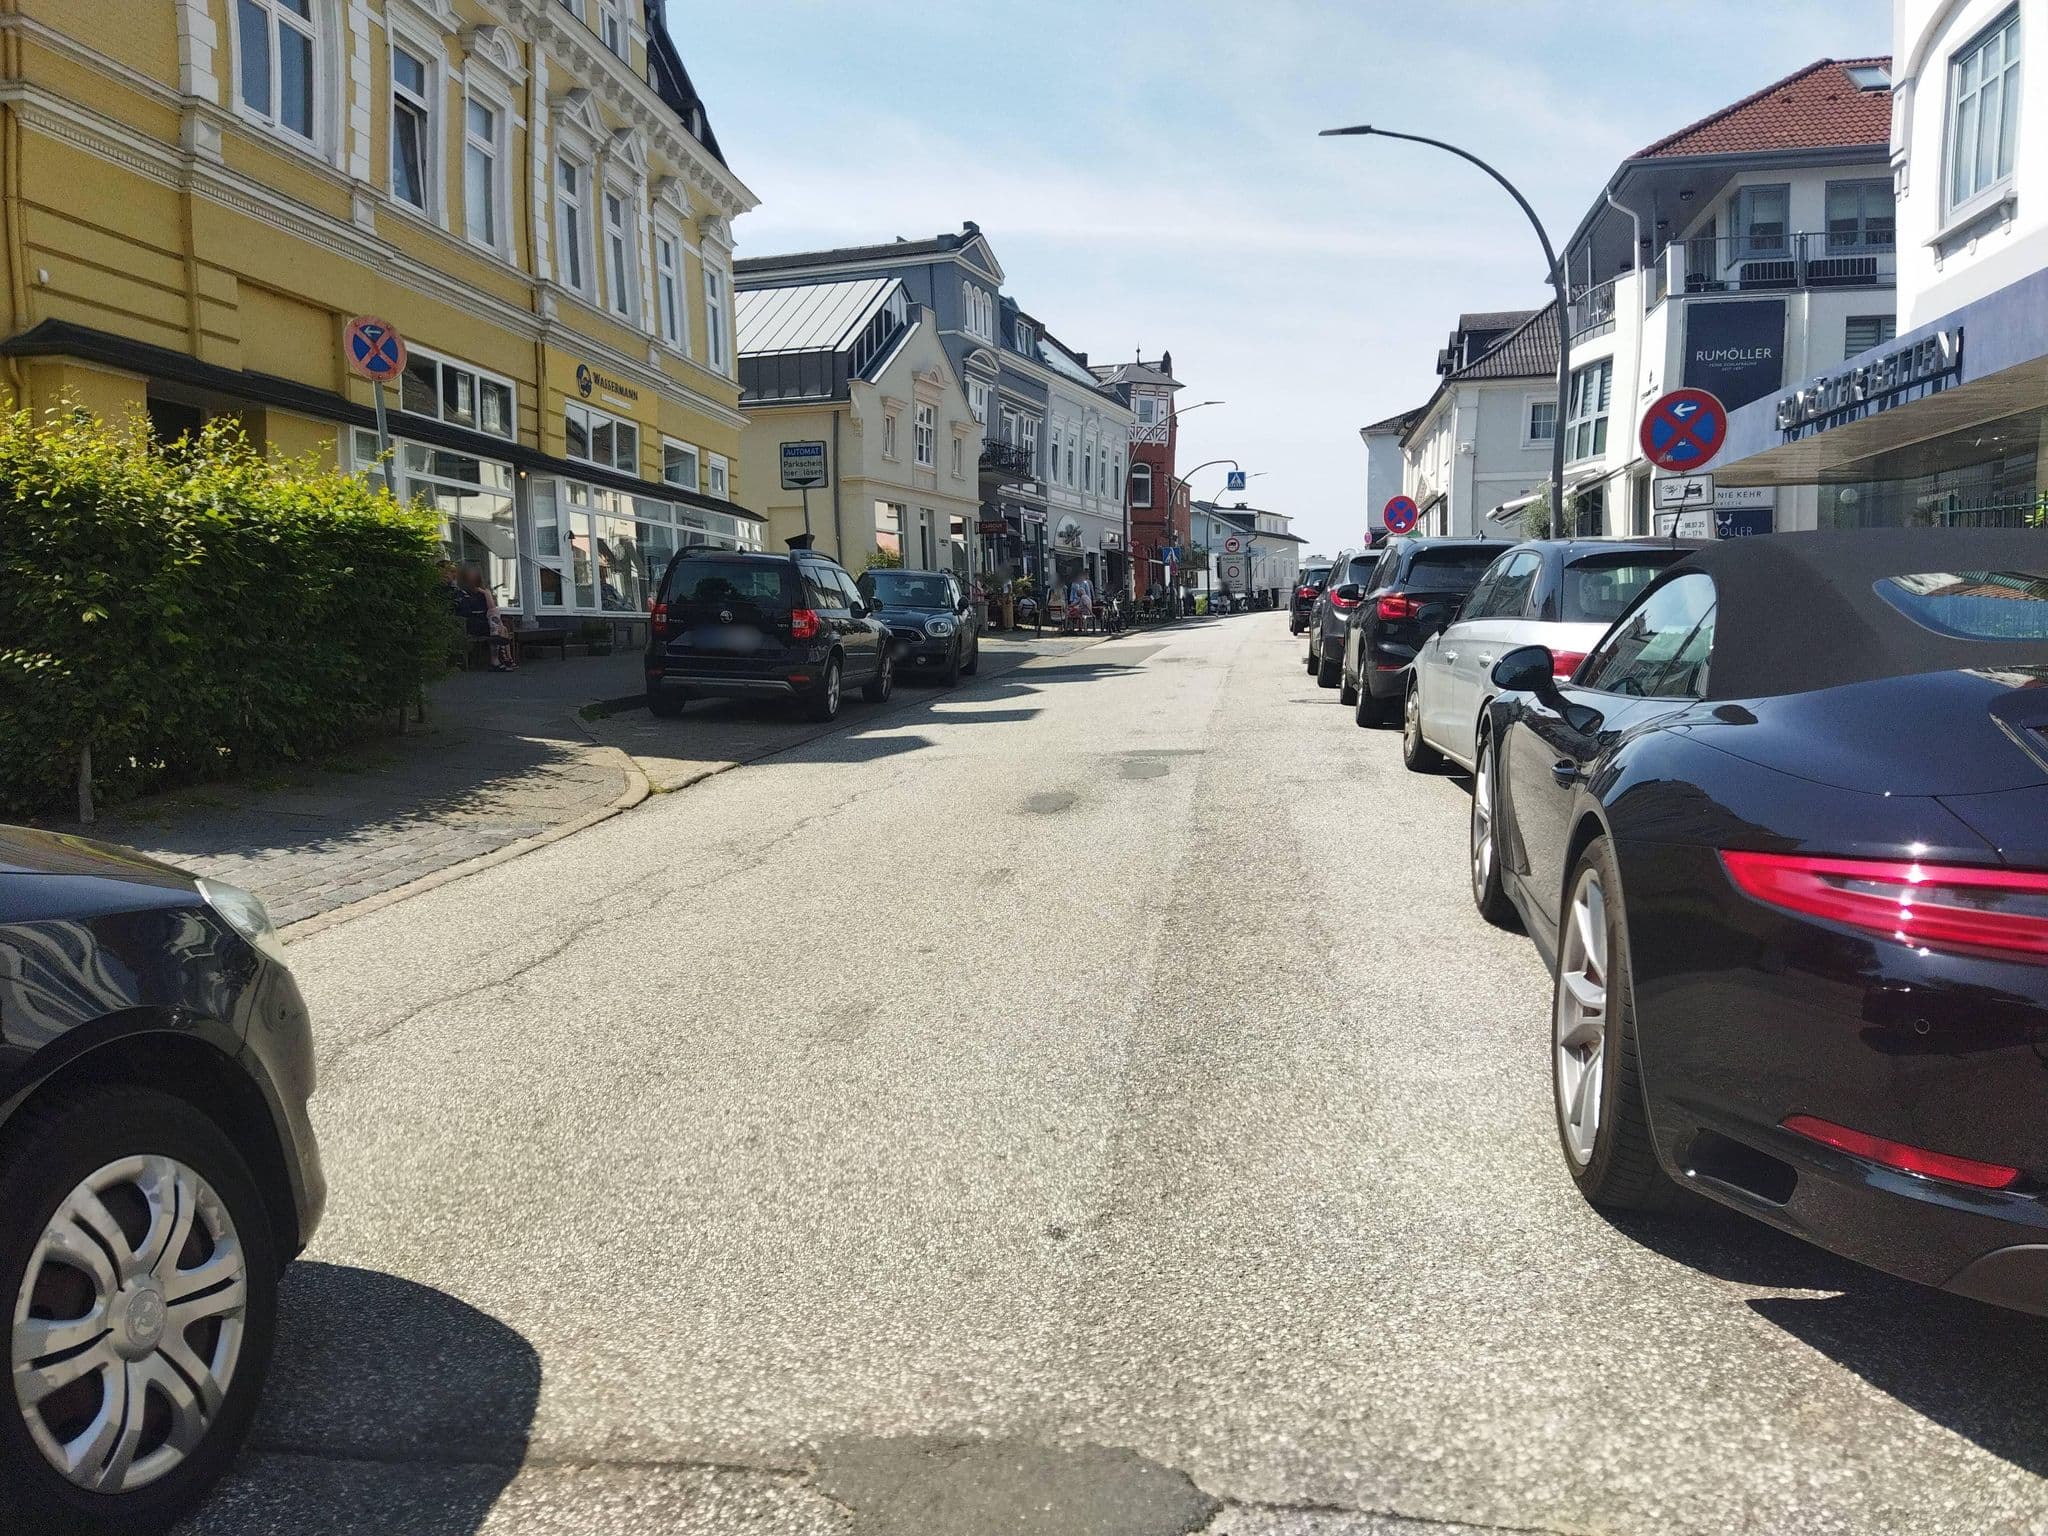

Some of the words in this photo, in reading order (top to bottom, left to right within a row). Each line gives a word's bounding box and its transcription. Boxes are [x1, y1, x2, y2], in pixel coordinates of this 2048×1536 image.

[1696, 347, 1772, 361] RUMÖLLER
[785, 447, 819, 456] AUTOMAT
[784, 460, 823, 468] Parkschein
[784, 469, 798, 477] hier
[803, 468, 824, 476] lösen
[1737, 490, 1762, 498] KEHR
